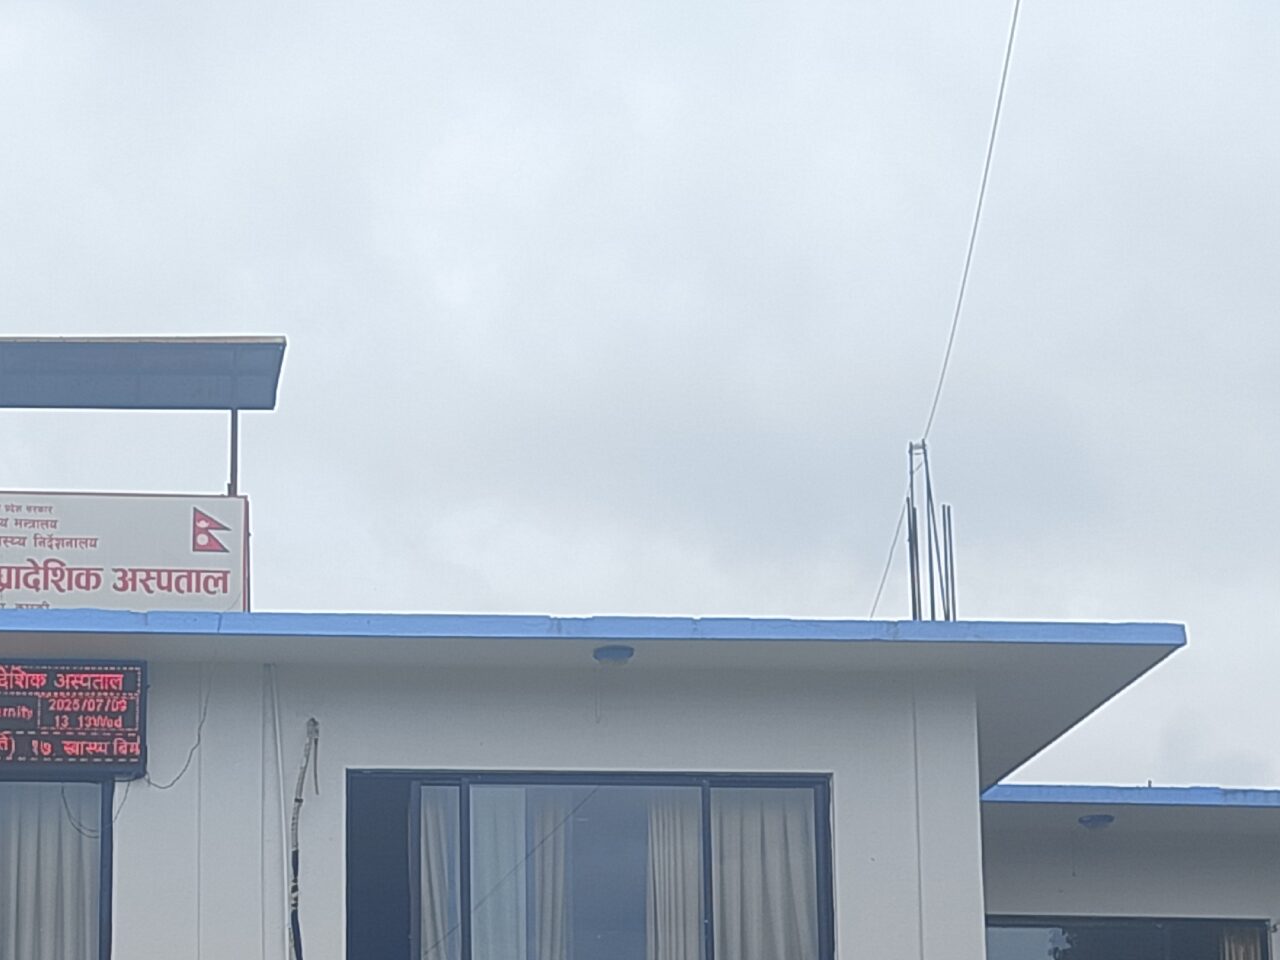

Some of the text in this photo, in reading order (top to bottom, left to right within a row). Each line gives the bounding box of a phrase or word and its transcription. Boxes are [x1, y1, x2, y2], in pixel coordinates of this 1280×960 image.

[14, 518, 59, 531] मन्त्रालय
[33, 533, 98, 551] निर्देशनालय
[112, 566, 231, 595] अस्पताल
[54, 672, 124, 691] अस्पताल
